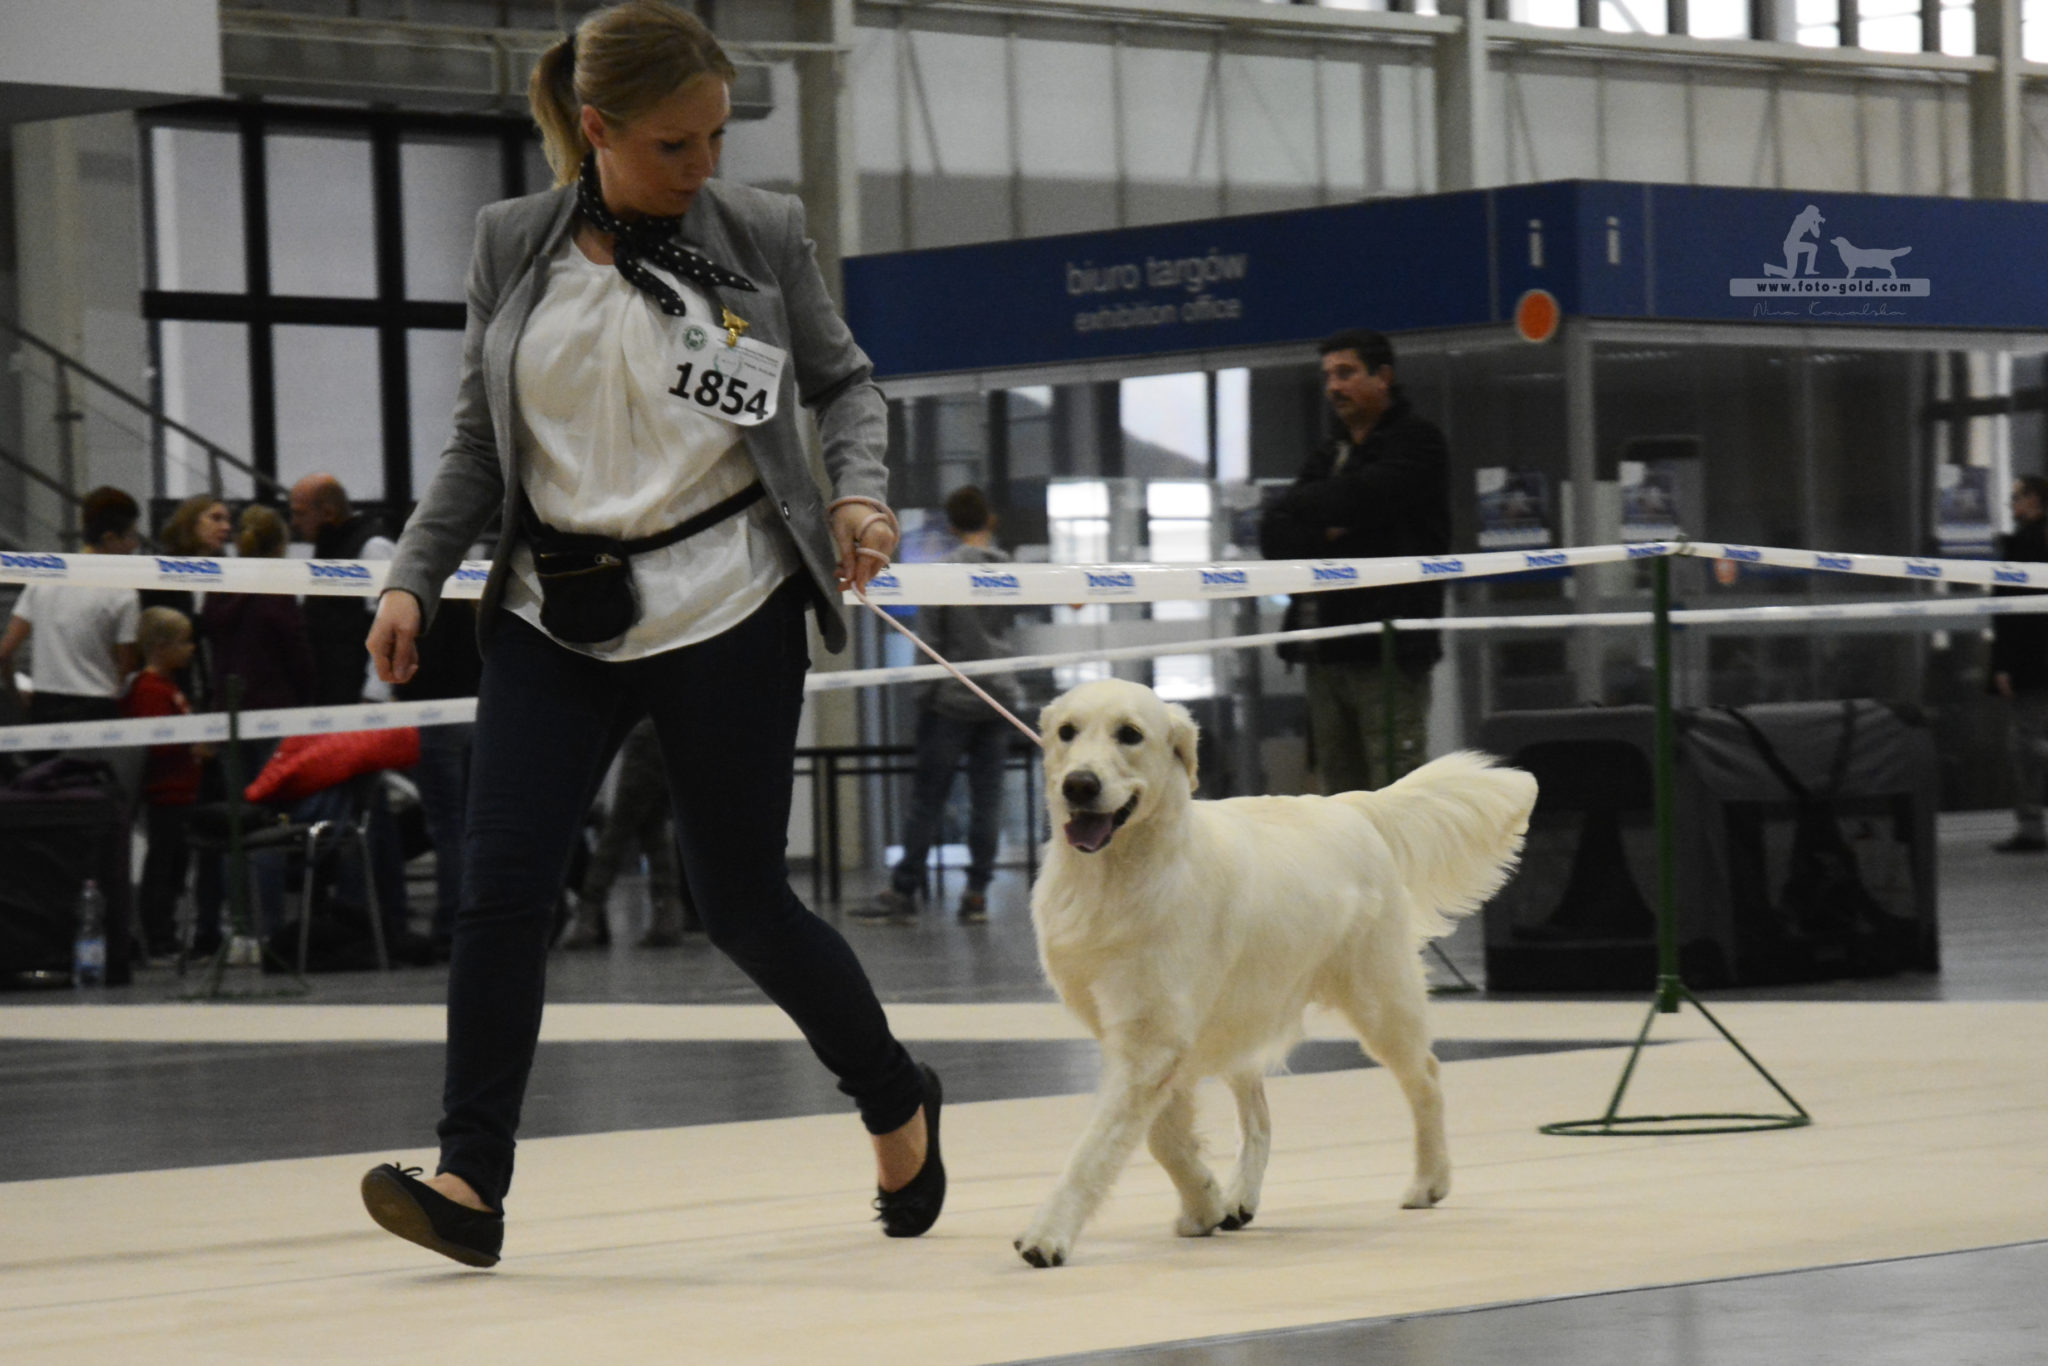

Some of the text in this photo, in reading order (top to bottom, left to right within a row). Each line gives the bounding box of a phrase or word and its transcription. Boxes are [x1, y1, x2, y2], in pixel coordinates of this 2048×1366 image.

[1066, 247, 1248, 294] biuro targów
[1074, 294, 1242, 331] exhibition office
[668, 361, 768, 420] 1854
